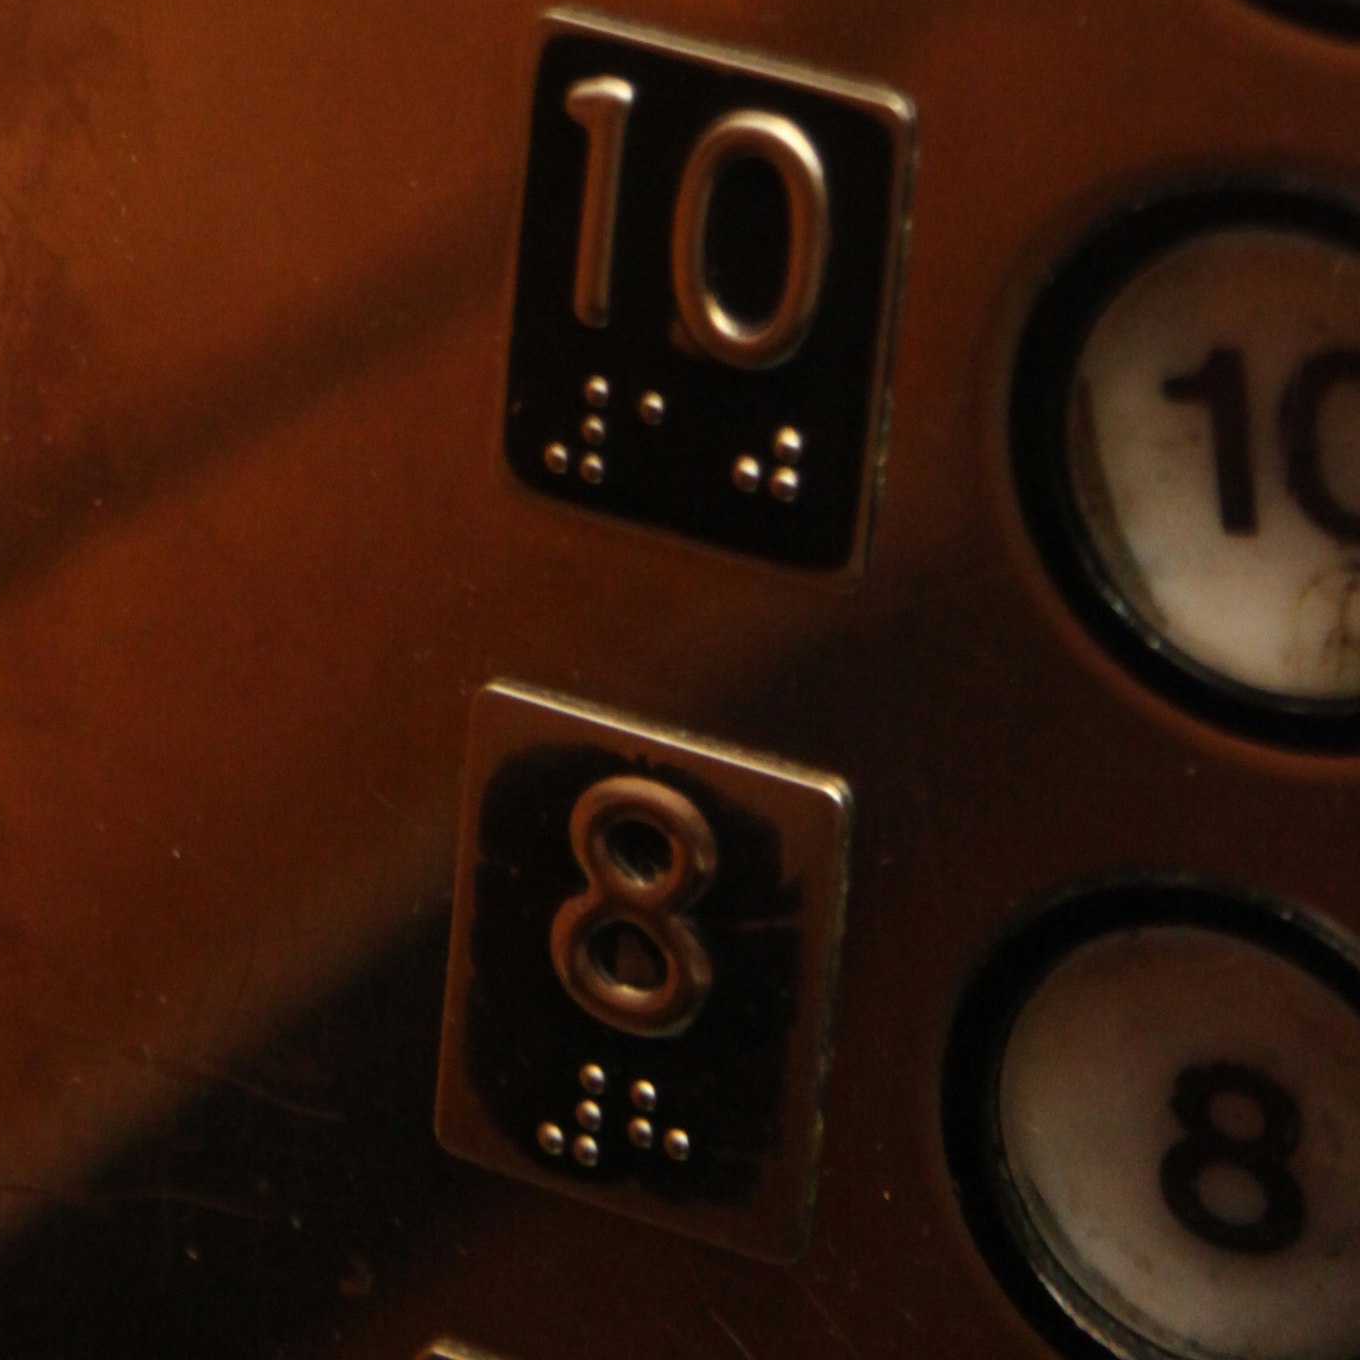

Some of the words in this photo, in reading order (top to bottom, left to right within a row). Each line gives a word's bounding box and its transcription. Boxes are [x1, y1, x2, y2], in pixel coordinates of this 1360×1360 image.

[565, 76, 830, 371] 10
[550, 774, 716, 1038] 8
[1160, 1060, 1306, 1255] 8
